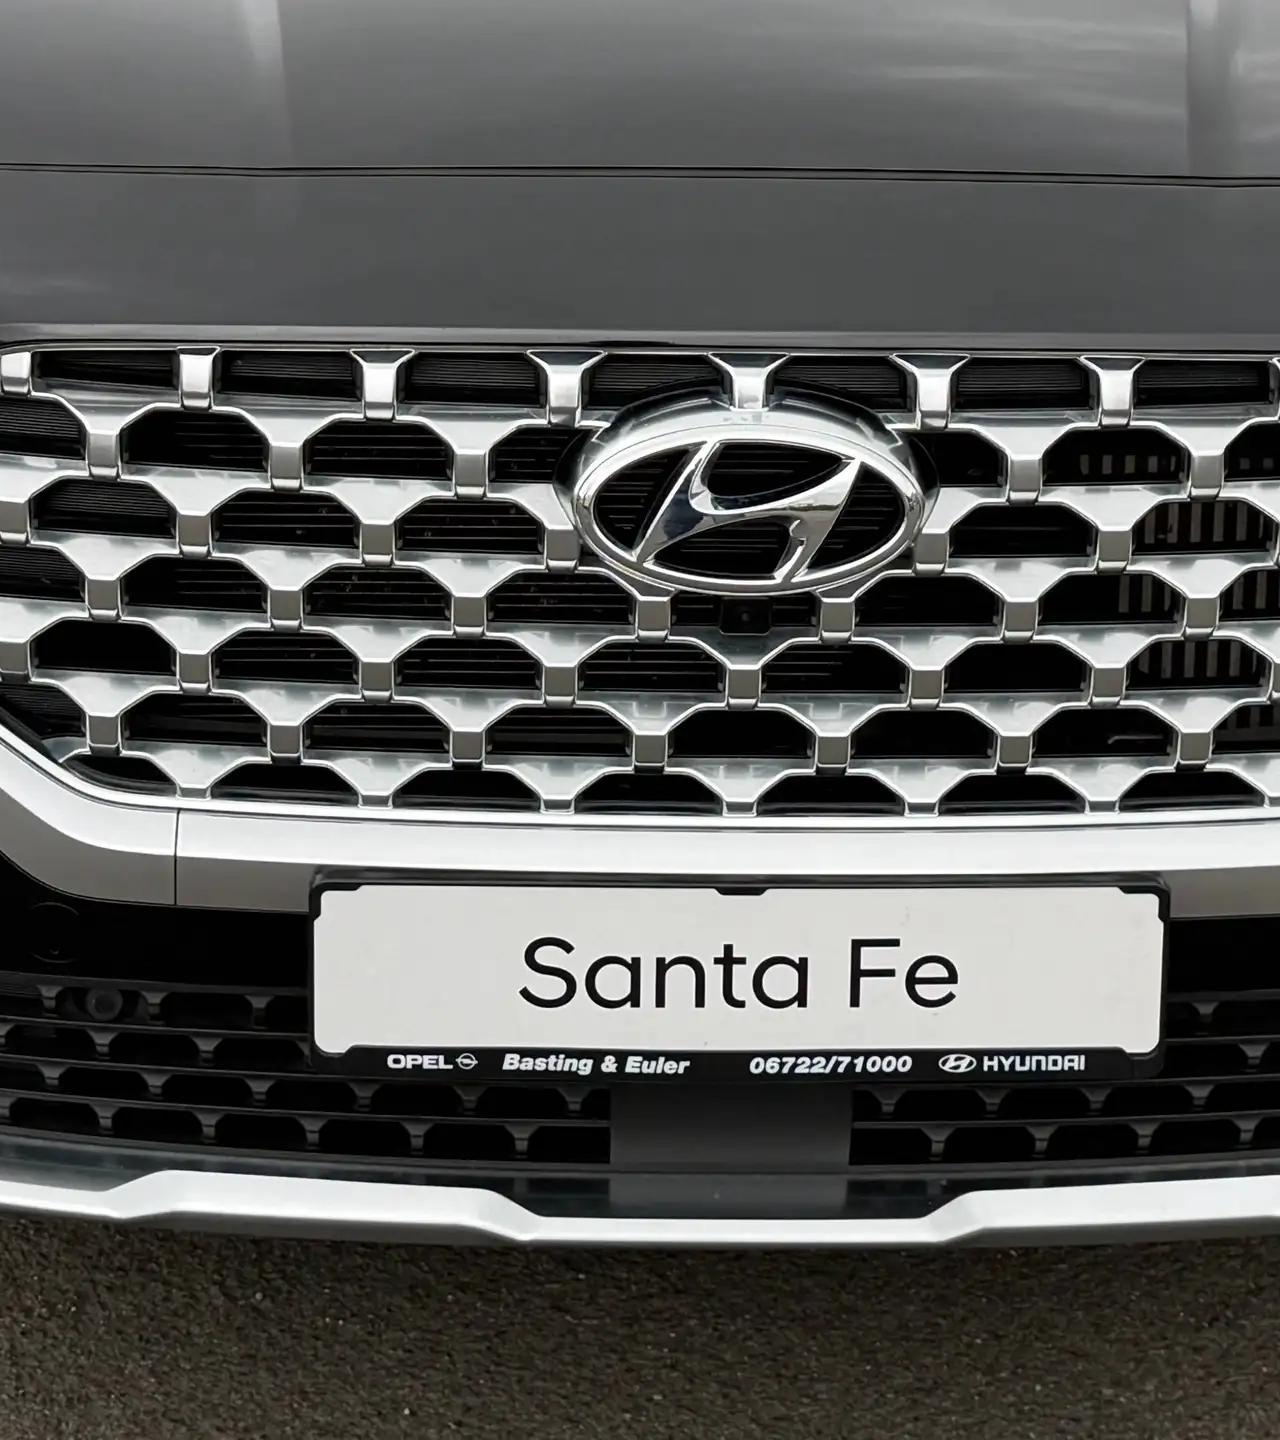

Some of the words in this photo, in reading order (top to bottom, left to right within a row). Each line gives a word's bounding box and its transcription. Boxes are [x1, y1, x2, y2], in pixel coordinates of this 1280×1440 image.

[518, 936, 809, 1009] Santa
[849, 937, 959, 1009] Fe
[387, 1053, 453, 1070] OPEL
[502, 1053, 593, 1075] Basting
[601, 1055, 617, 1073] &
[625, 1055, 690, 1074] Euler
[749, 1054, 912, 1074] 06722/71000
[983, 1054, 1085, 1072] HYUNDAI
